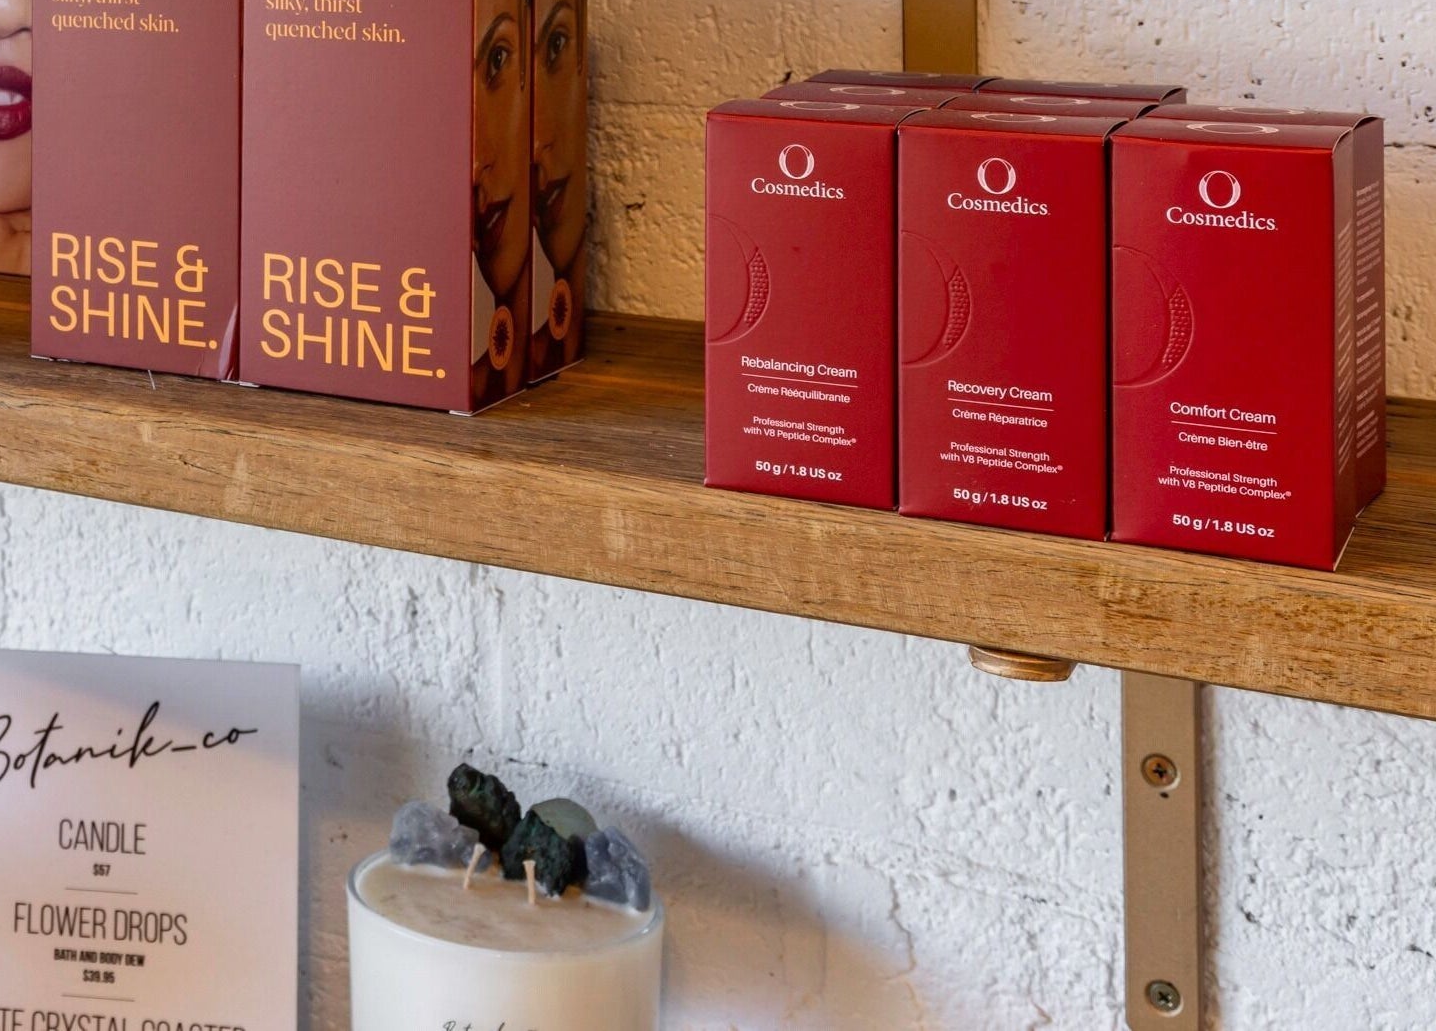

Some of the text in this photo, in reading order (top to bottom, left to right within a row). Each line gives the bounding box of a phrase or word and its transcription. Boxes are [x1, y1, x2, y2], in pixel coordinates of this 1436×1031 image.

[52, 12, 179, 33] quenched skin.
[265, 20, 406, 43] quenched skin.
[751, 177, 845, 200] Cosmedics
[947, 192, 1049, 217] Cosmedics
[1166, 206, 1276, 231] Cosmedics
[51, 232, 209, 293] RISE &
[263, 252, 436, 319] RISE &
[50, 285, 217, 350] SHINE.
[261, 308, 446, 379] SHINE.
[741, 356, 857, 379] Rebalancing Cream
[747, 383, 851, 403] Crème Rééquilibrante
[948, 379, 1053, 402] Recovery Cream
[952, 408, 1048, 428] Crème Réparatrice
[1170, 401, 1277, 425] Comfort Cream
[744, 427, 762, 435] with
[764, 428, 775, 437] V8
[777, 430, 811, 442] Peptide
[753, 416, 845, 436] Professional Strength
[950, 441, 1050, 462] Professional Strength
[1178, 431, 1268, 452] Crème Bien-être
[755, 461, 771, 472] 50
[773, 464, 781, 475] g
[789, 465, 807, 476] 1.8
[810, 467, 826, 478] US
[828, 471, 843, 481] oz
[940, 452, 960, 462] with
[962, 455, 975, 464] V8
[977, 456, 1013, 468] Peptide
[1158, 477, 1180, 487] with
[1182, 479, 1196, 489] V8
[1198, 481, 1237, 494] Peptide
[1169, 465, 1278, 488] Professional Strength
[953, 488, 969, 500] 50
[972, 492, 981, 504] g
[990, 493, 1009, 505] 1.8
[1012, 496, 1030, 508] US
[1031, 499, 1048, 510] oz
[1172, 513, 1191, 527] 50
[1193, 517, 1203, 531] g
[1212, 519, 1233, 533] 1.8
[1235, 522, 1256, 535] US
[1257, 527, 1275, 538] oz
[58, 818, 147, 855] CANDLE
[92, 863, 111, 877] $57
[14, 902, 188, 946] FLOWER DROPS
[53, 948, 146, 968] BATH AND BODY DEW
[82, 969, 115, 984] $39.95
